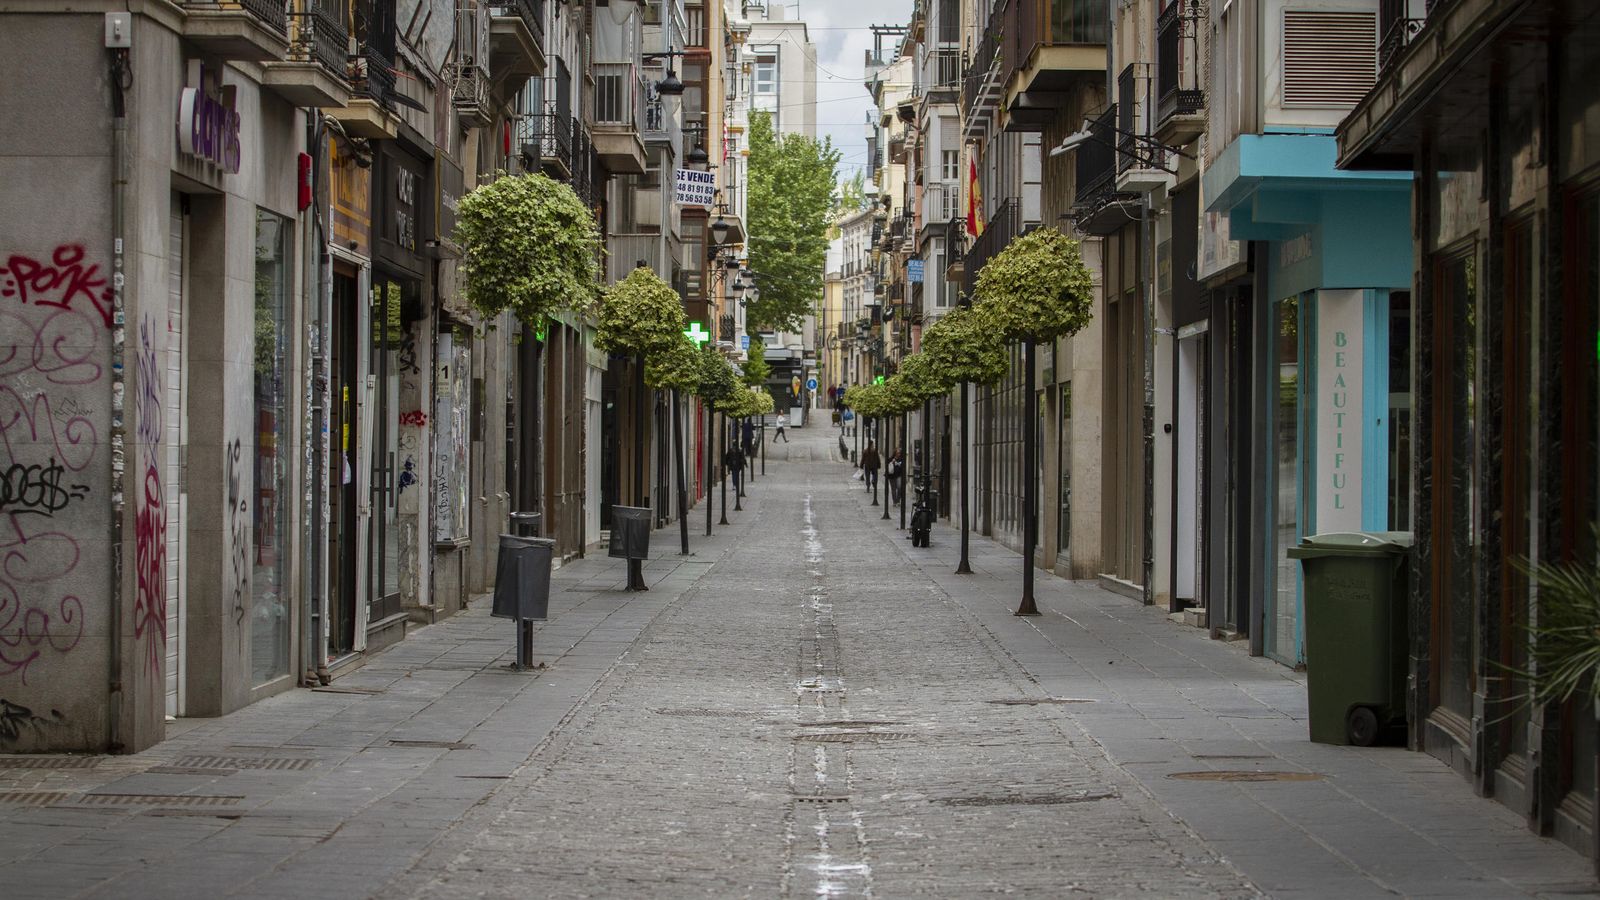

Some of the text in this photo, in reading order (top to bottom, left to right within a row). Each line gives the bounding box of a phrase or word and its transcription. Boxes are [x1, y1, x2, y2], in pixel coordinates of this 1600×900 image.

[676, 170, 714, 184] SE VENDE
[688, 184, 695, 192] 81
[696, 185, 703, 193] 91
[685, 194, 694, 202] 56
[1333, 331, 1347, 510] BEAUTIFUL
